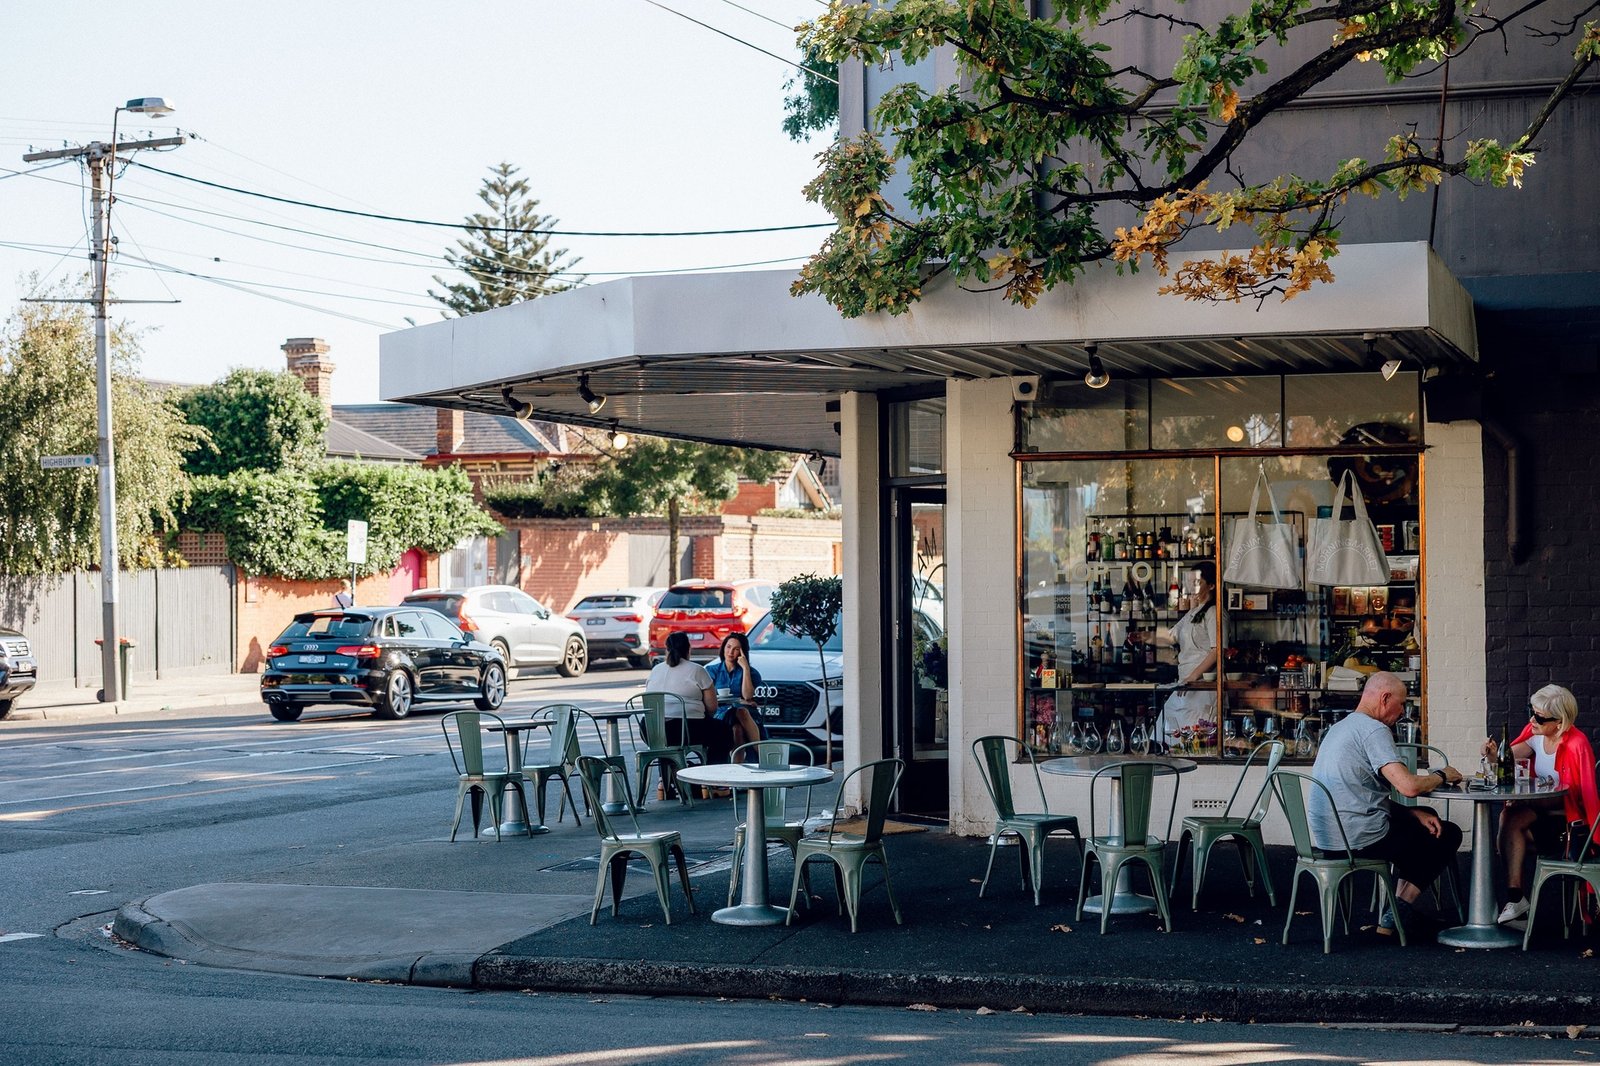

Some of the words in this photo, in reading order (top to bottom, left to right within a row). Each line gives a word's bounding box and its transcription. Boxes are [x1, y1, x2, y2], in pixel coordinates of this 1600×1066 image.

[42, 458, 76, 466] HIGHBURY
[1055, 561, 1109, 582] HOP
[1116, 561, 1153, 582] TO
[1160, 561, 1185, 582] IT
[765, 707, 780, 716] 260
